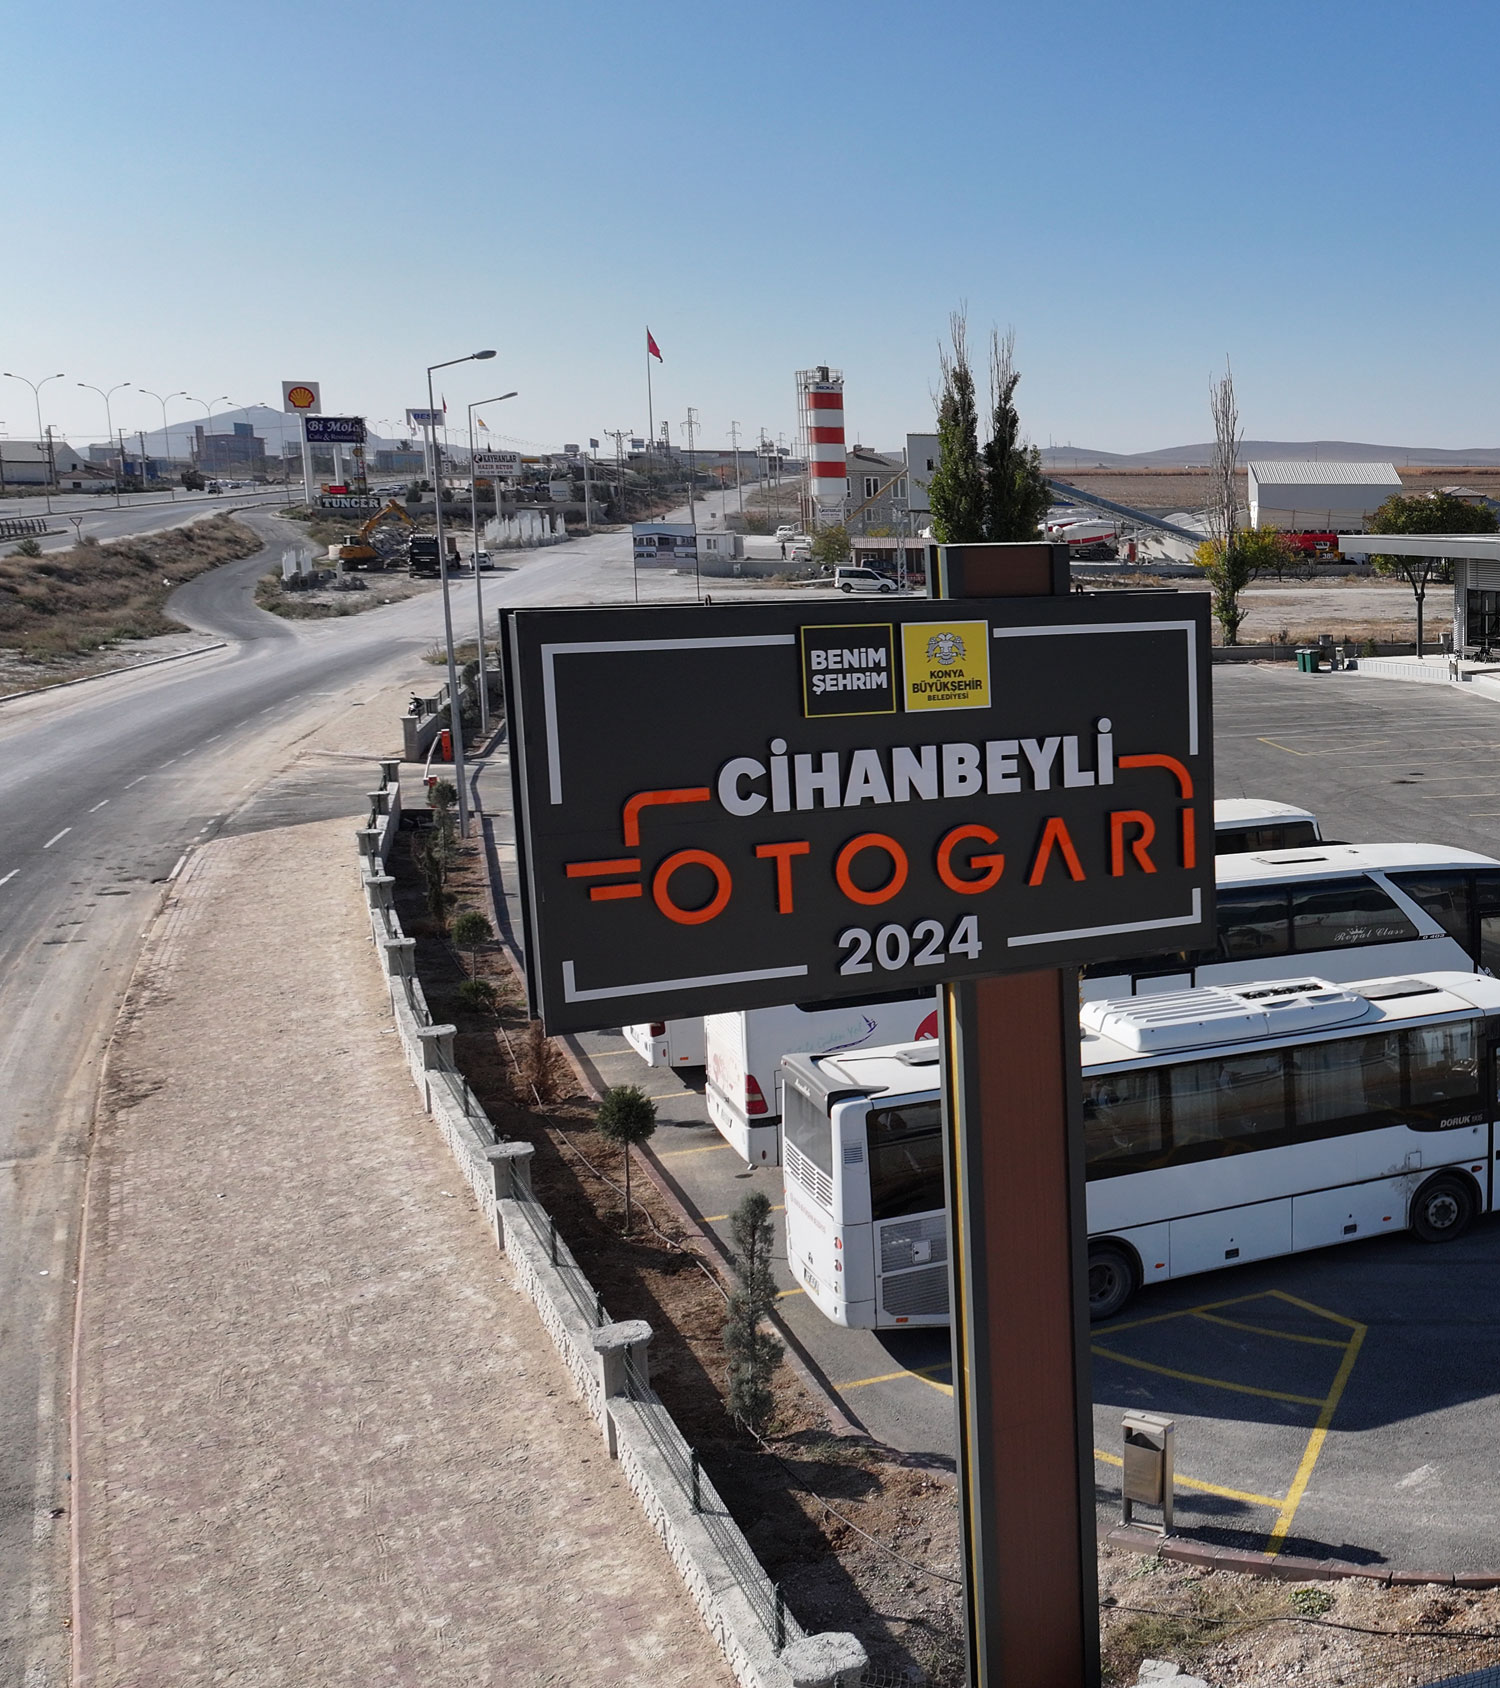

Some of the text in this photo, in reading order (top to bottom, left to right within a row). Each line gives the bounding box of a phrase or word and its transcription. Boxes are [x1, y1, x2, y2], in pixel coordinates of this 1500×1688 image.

[929, 668, 965, 679] KONYA
[912, 677, 983, 694] BÜYÜKŞEHİR
[927, 691, 969, 701] BELEDİYESİ
[717, 717, 1115, 817] CİHANBEYLİ
[1334, 928, 1372, 943] Royal
[837, 914, 983, 977] 2024
[1440, 1115, 1471, 1128] DORUK
